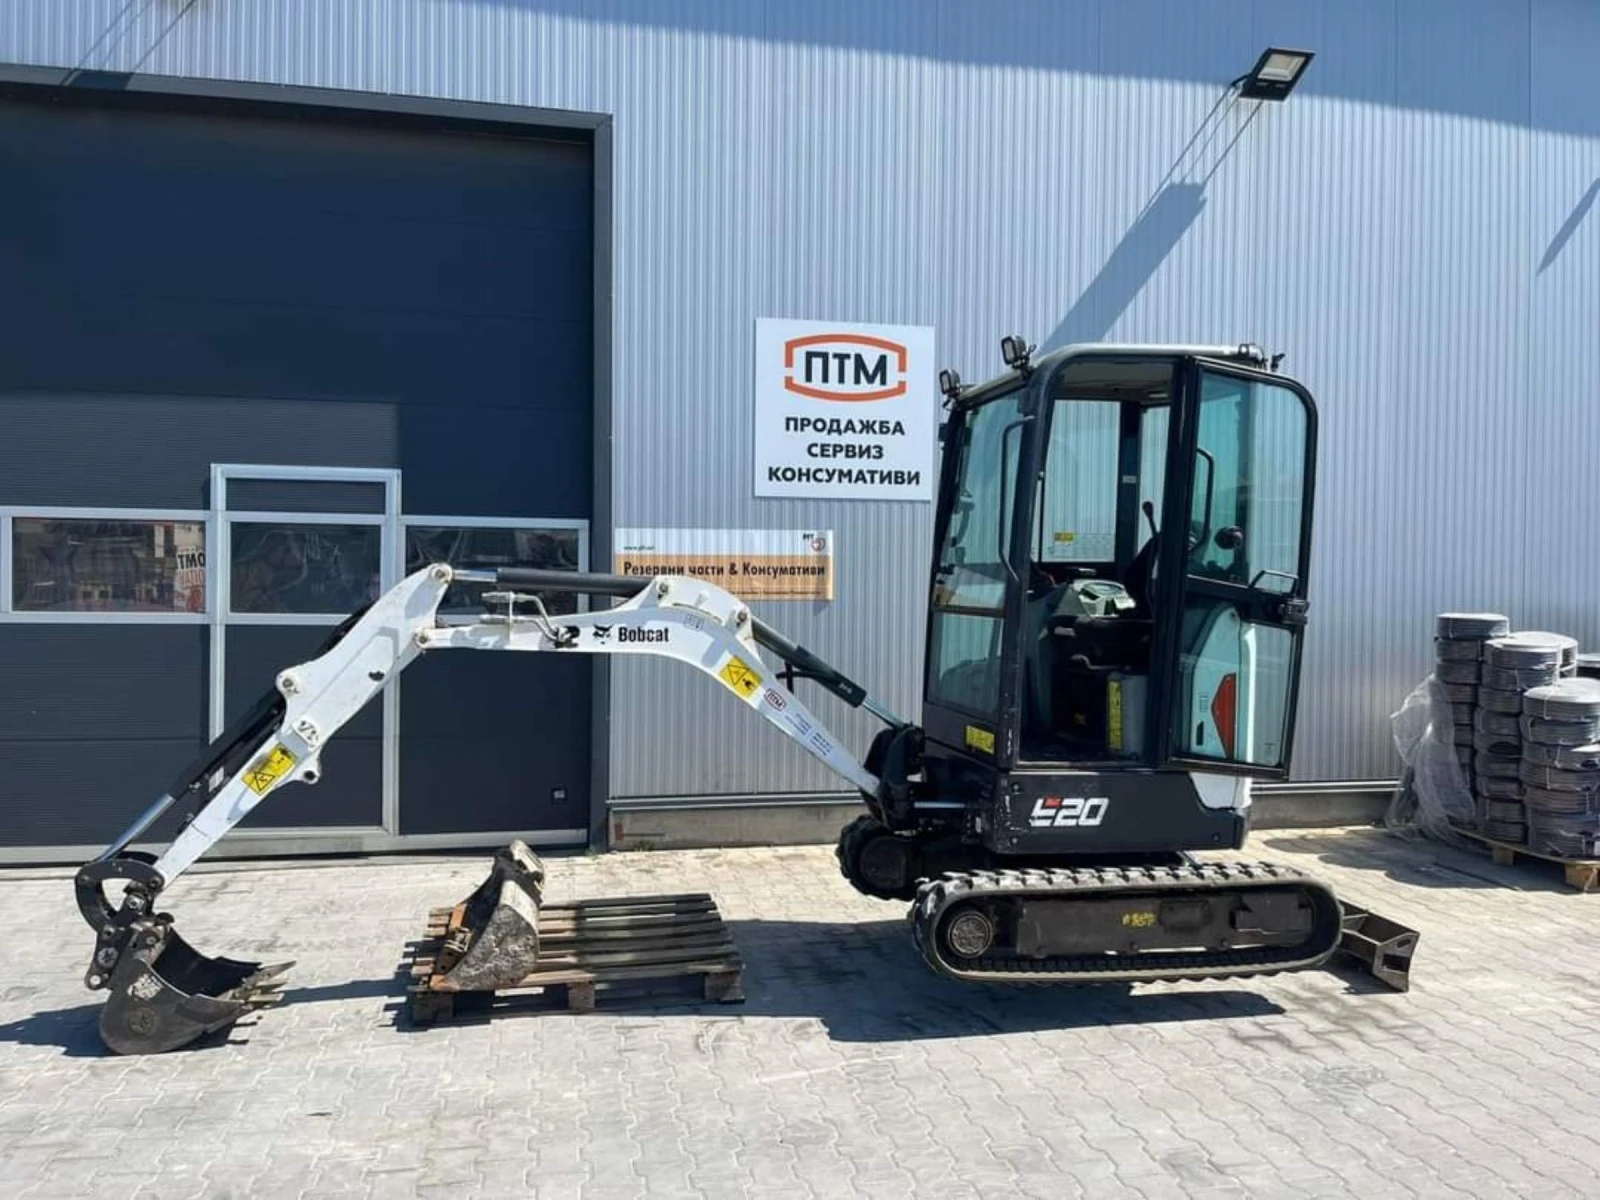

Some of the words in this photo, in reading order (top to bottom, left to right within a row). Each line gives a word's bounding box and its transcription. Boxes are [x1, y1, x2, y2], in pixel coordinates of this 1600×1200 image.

[804, 351, 887, 386] ПТМ
[785, 416, 905, 436] ПРОДАЖБА
[807, 443, 884, 459] СЕРВИЗ
[768, 467, 920, 485] КОНСУМАТИВИ
[623, 561, 685, 576] Резервни
[688, 565, 724, 576] части
[729, 562, 738, 576] &
[743, 562, 825, 579] Консумативи
[618, 626, 669, 643] Bobcat
[1028, 796, 1109, 827] E20
